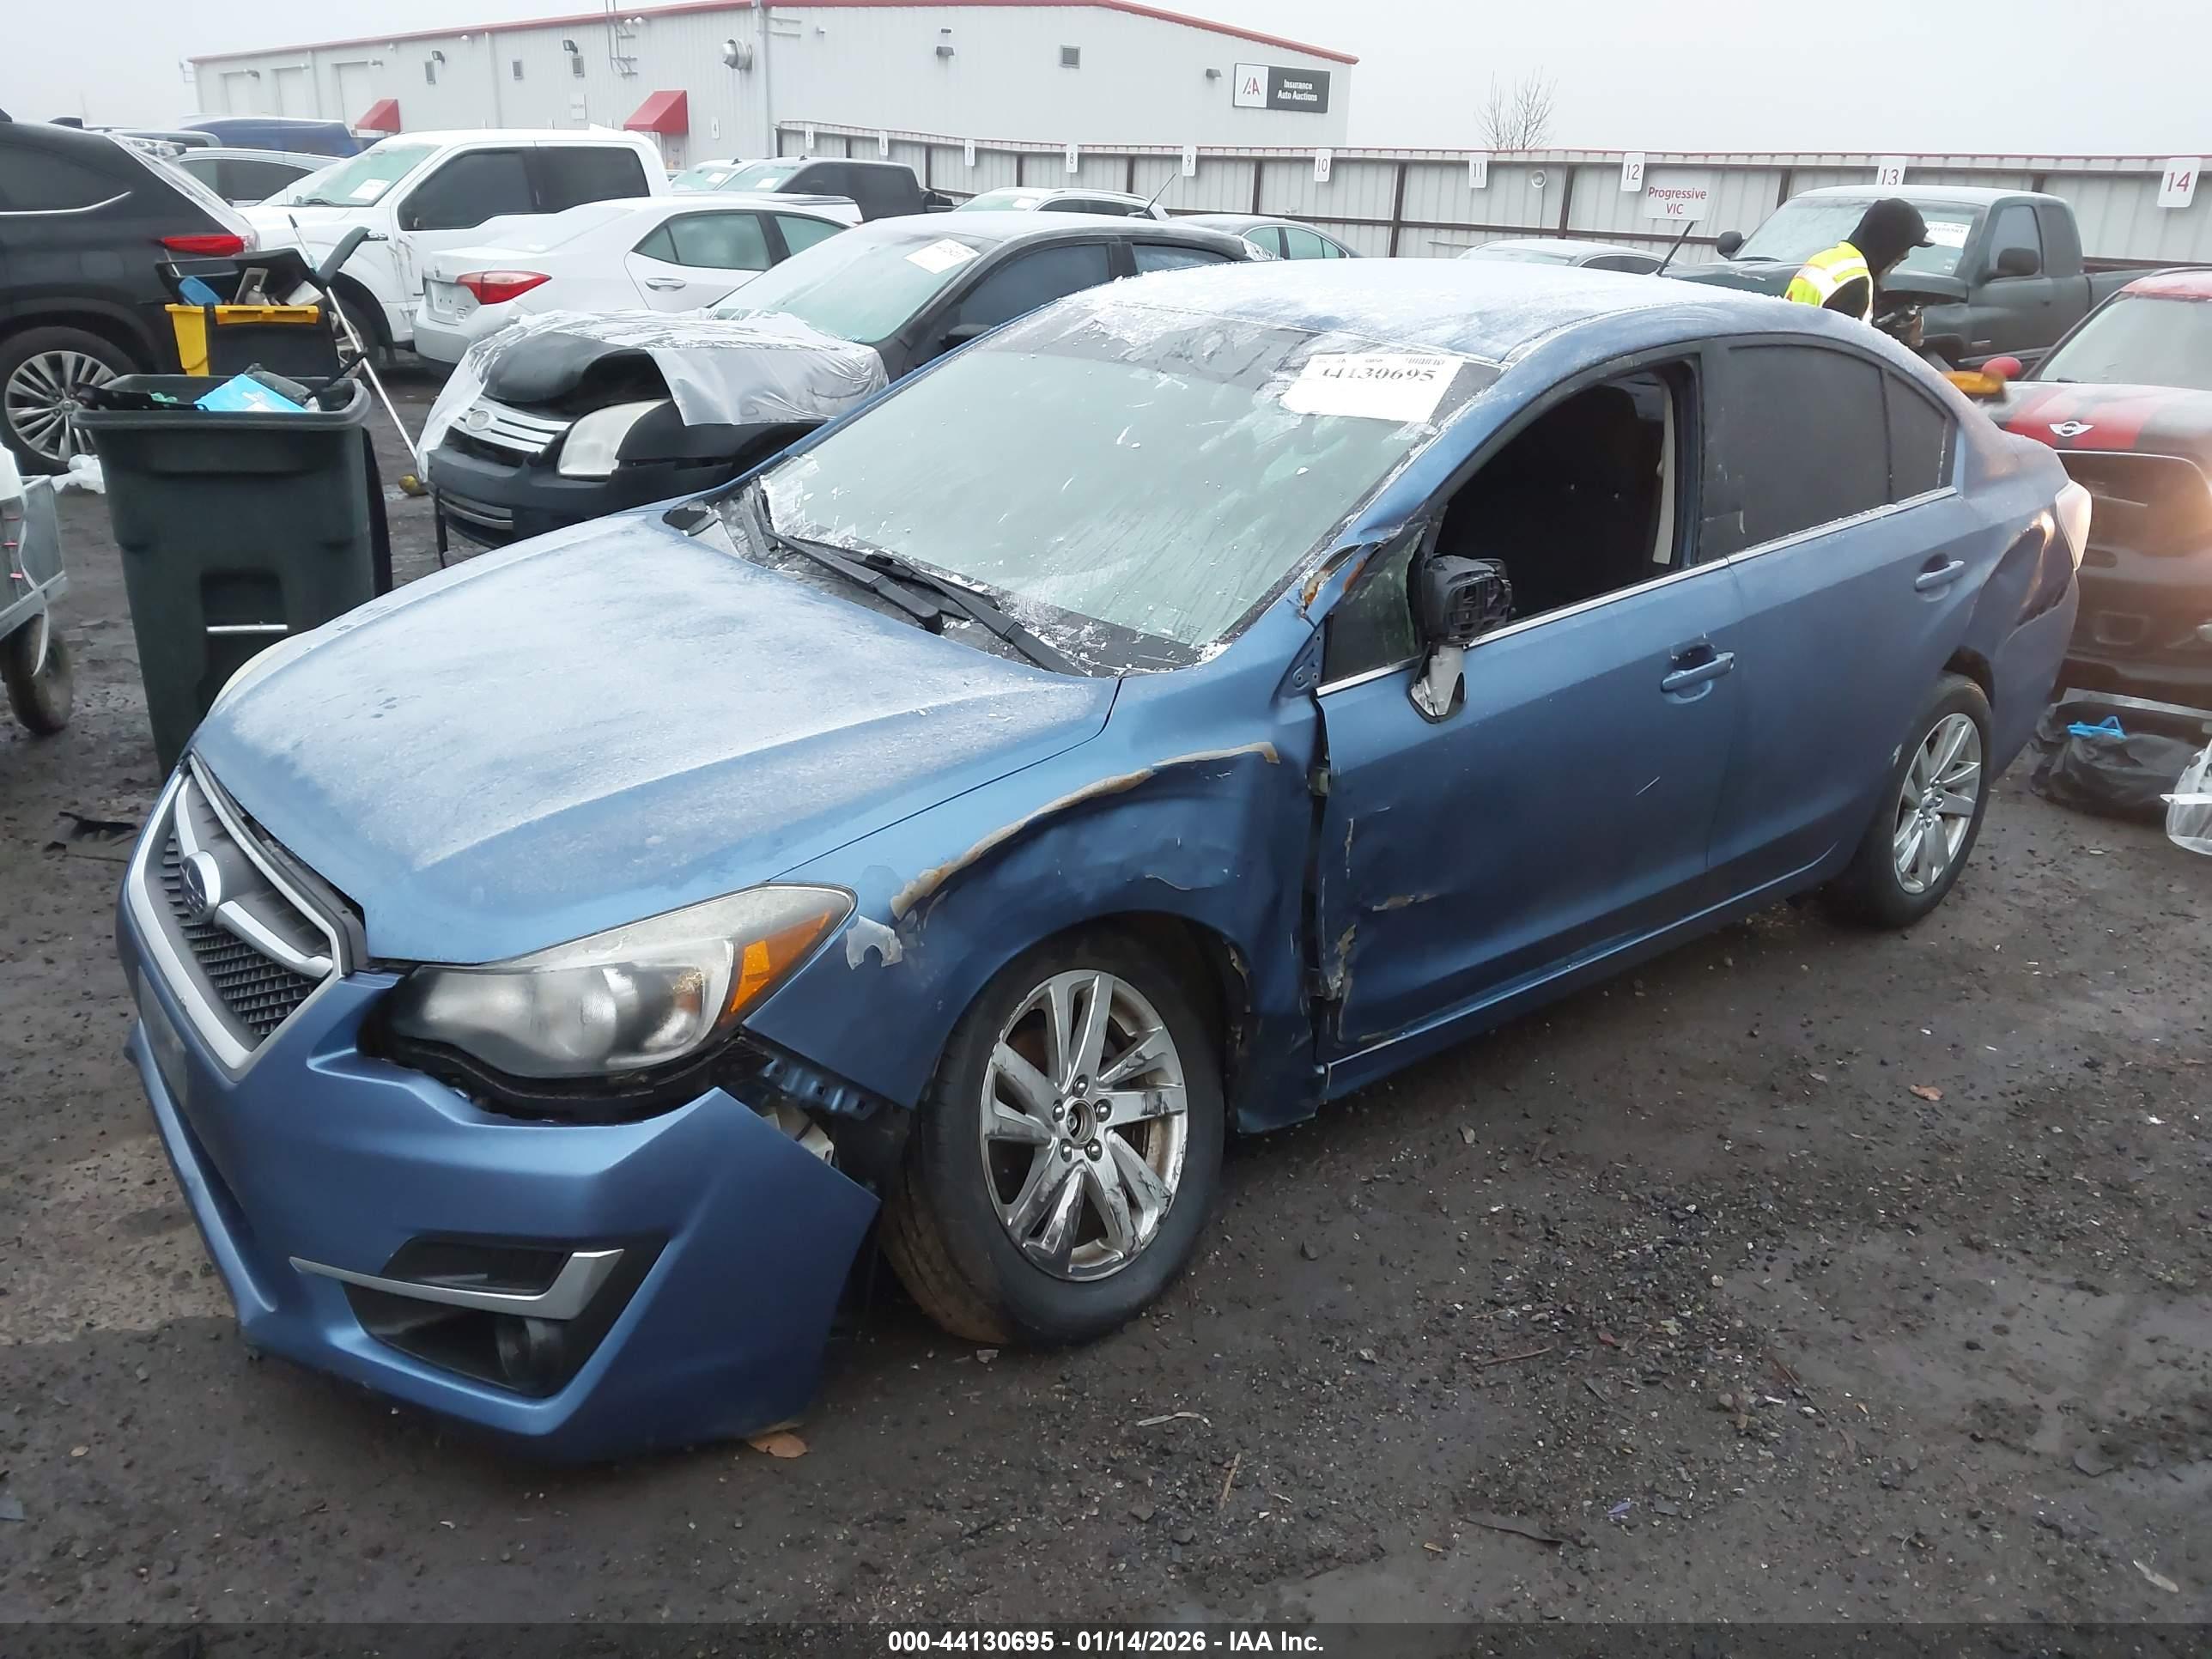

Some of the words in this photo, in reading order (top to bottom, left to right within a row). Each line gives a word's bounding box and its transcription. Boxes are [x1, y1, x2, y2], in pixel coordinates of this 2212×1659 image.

[1284, 79, 1313, 90] Insurance
[1277, 89, 1292, 100] Auto
[1292, 90, 1318, 101] Auctions
[1069, 152, 1074, 164] 8
[1317, 158, 1328, 173] 10
[1474, 162, 1483, 178] 11
[1626, 164, 1641, 180] 12
[1881, 168, 1899, 185] 13
[2167, 171, 2191, 192] 14
[1648, 185, 1708, 201] Progressive
[1666, 203, 1684, 215] VIC
